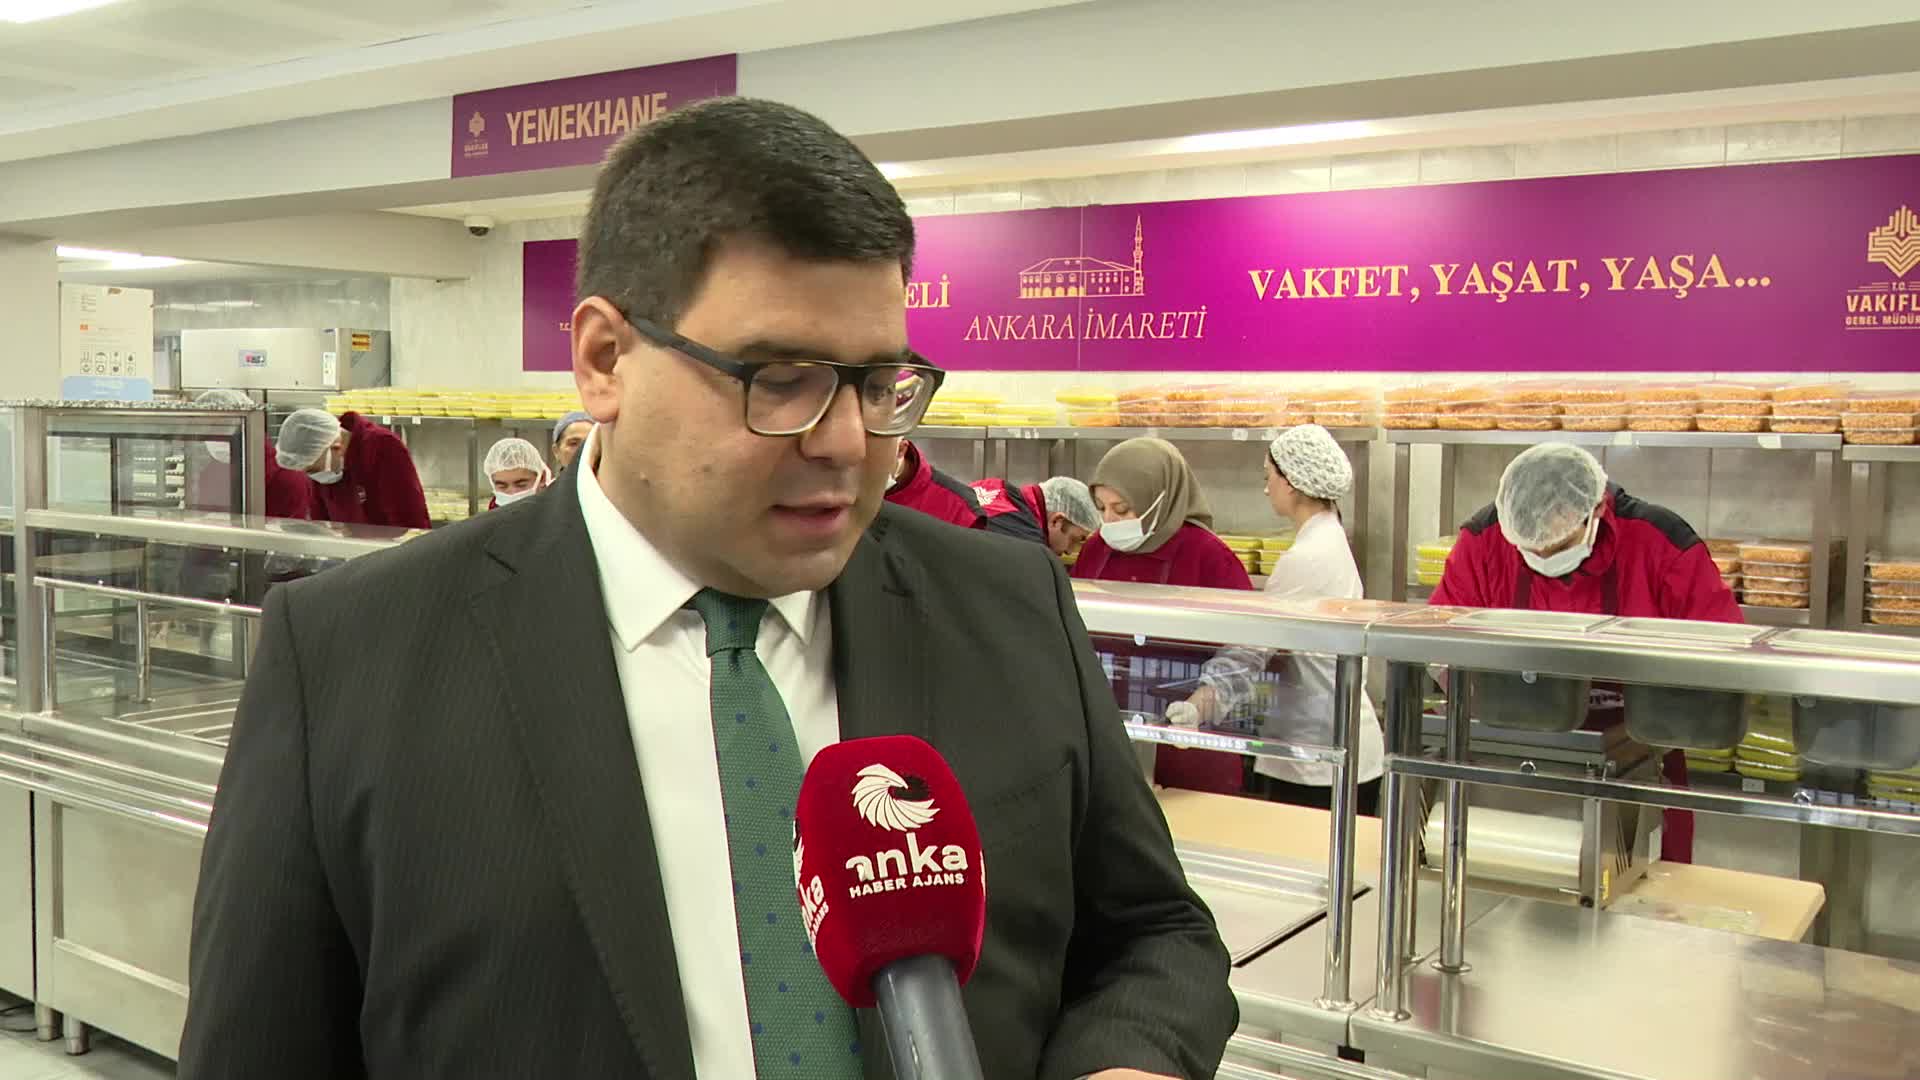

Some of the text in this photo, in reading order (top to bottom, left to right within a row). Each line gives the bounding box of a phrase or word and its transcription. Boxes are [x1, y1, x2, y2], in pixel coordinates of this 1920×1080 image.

[506, 92, 668, 146] YEMEKHANE
[1248, 254, 1771, 303] VAKFET, YAŞAT, YAŞA...
[964, 305, 1207, 341] ANKARA İMARETİ
[1845, 315, 1879, 326] GENEL
[845, 831, 969, 882] anka
[848, 872, 965, 899] HABER AJANS
